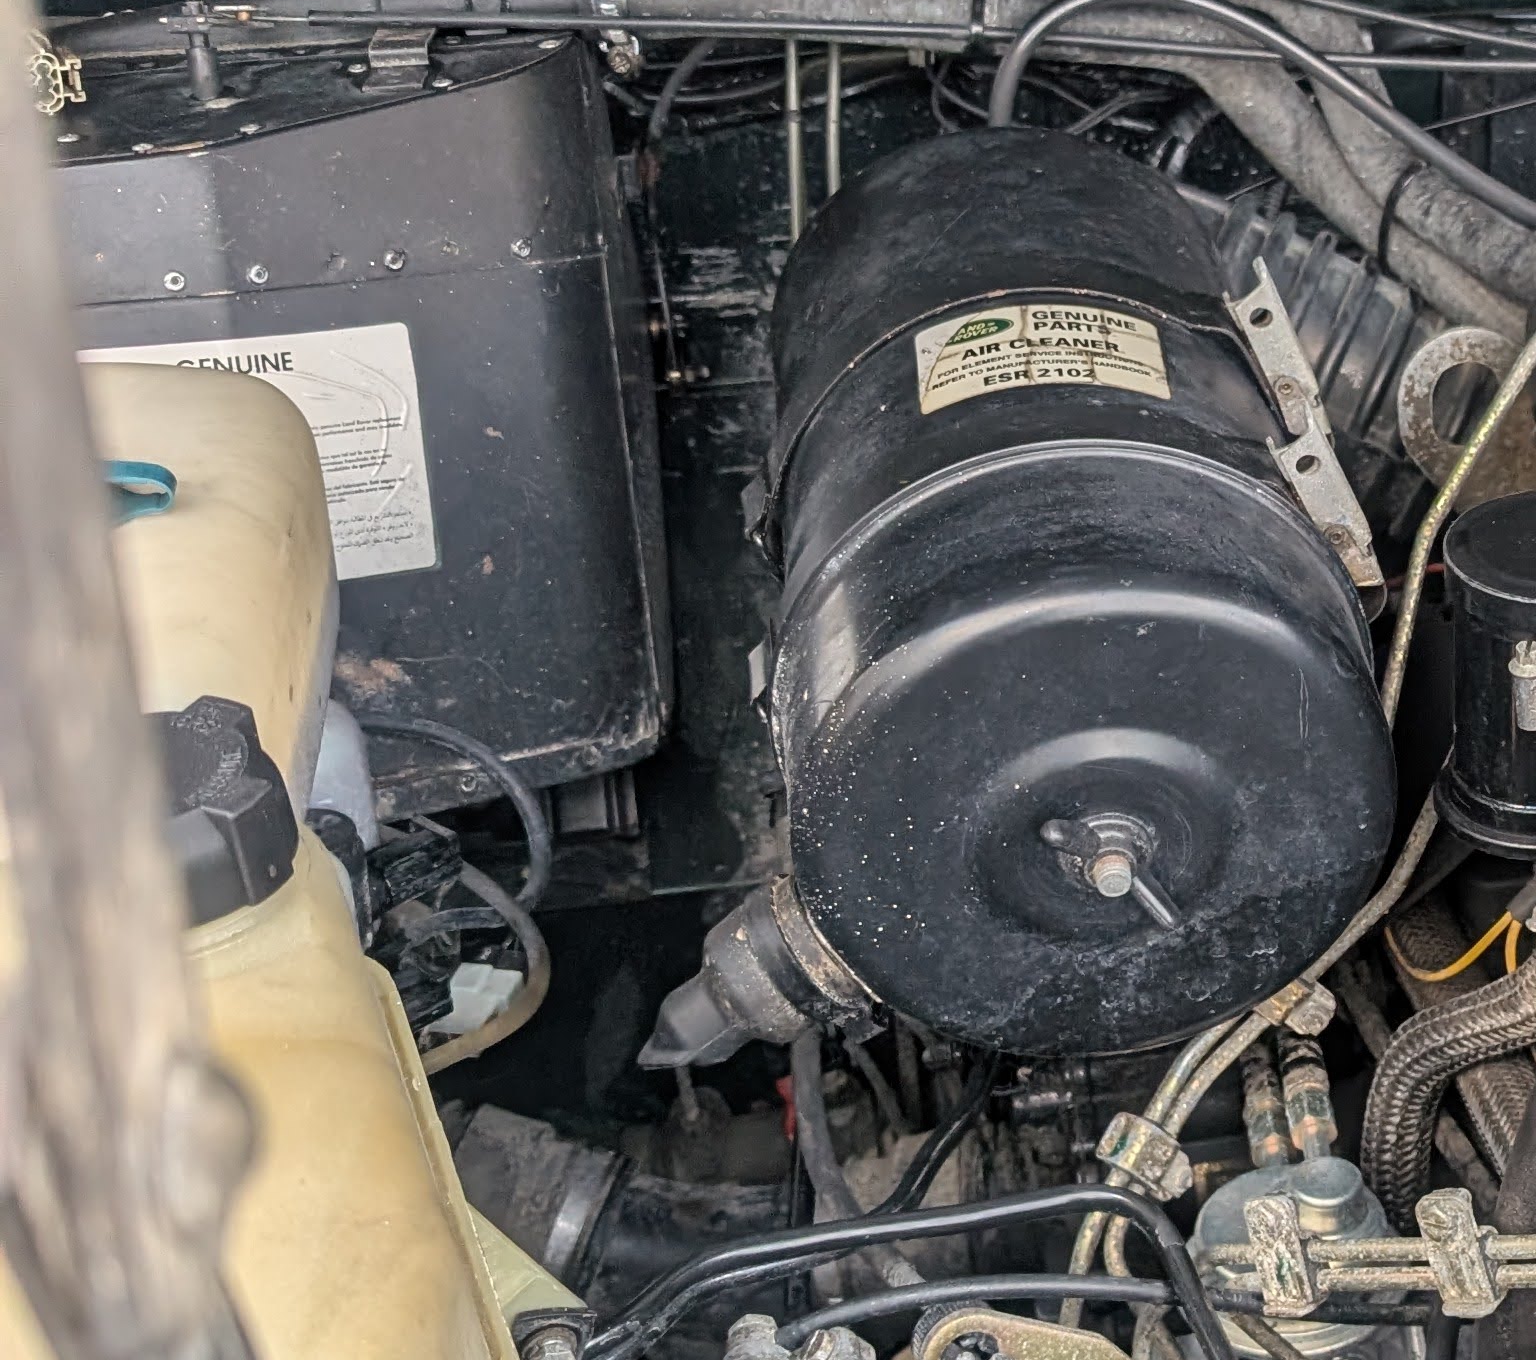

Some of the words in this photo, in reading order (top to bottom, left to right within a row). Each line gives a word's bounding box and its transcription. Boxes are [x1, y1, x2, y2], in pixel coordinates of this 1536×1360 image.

[1032, 311, 1137, 332] GENUINE
[1033, 321, 1111, 335] PARTS
[961, 342, 1002, 361] AIR
[1009, 338, 1120, 353] CLEANER
[932, 374, 967, 391] REFER
[968, 368, 984, 378] TO
[986, 358, 1089, 373] MANUFACTURER'S
[937, 367, 959, 380] FOR
[961, 354, 1013, 371] ELEMENT
[1014, 350, 1062, 359] SERVICE
[983, 370, 1029, 387] ESR
[1037, 367, 1095, 379] 2102
